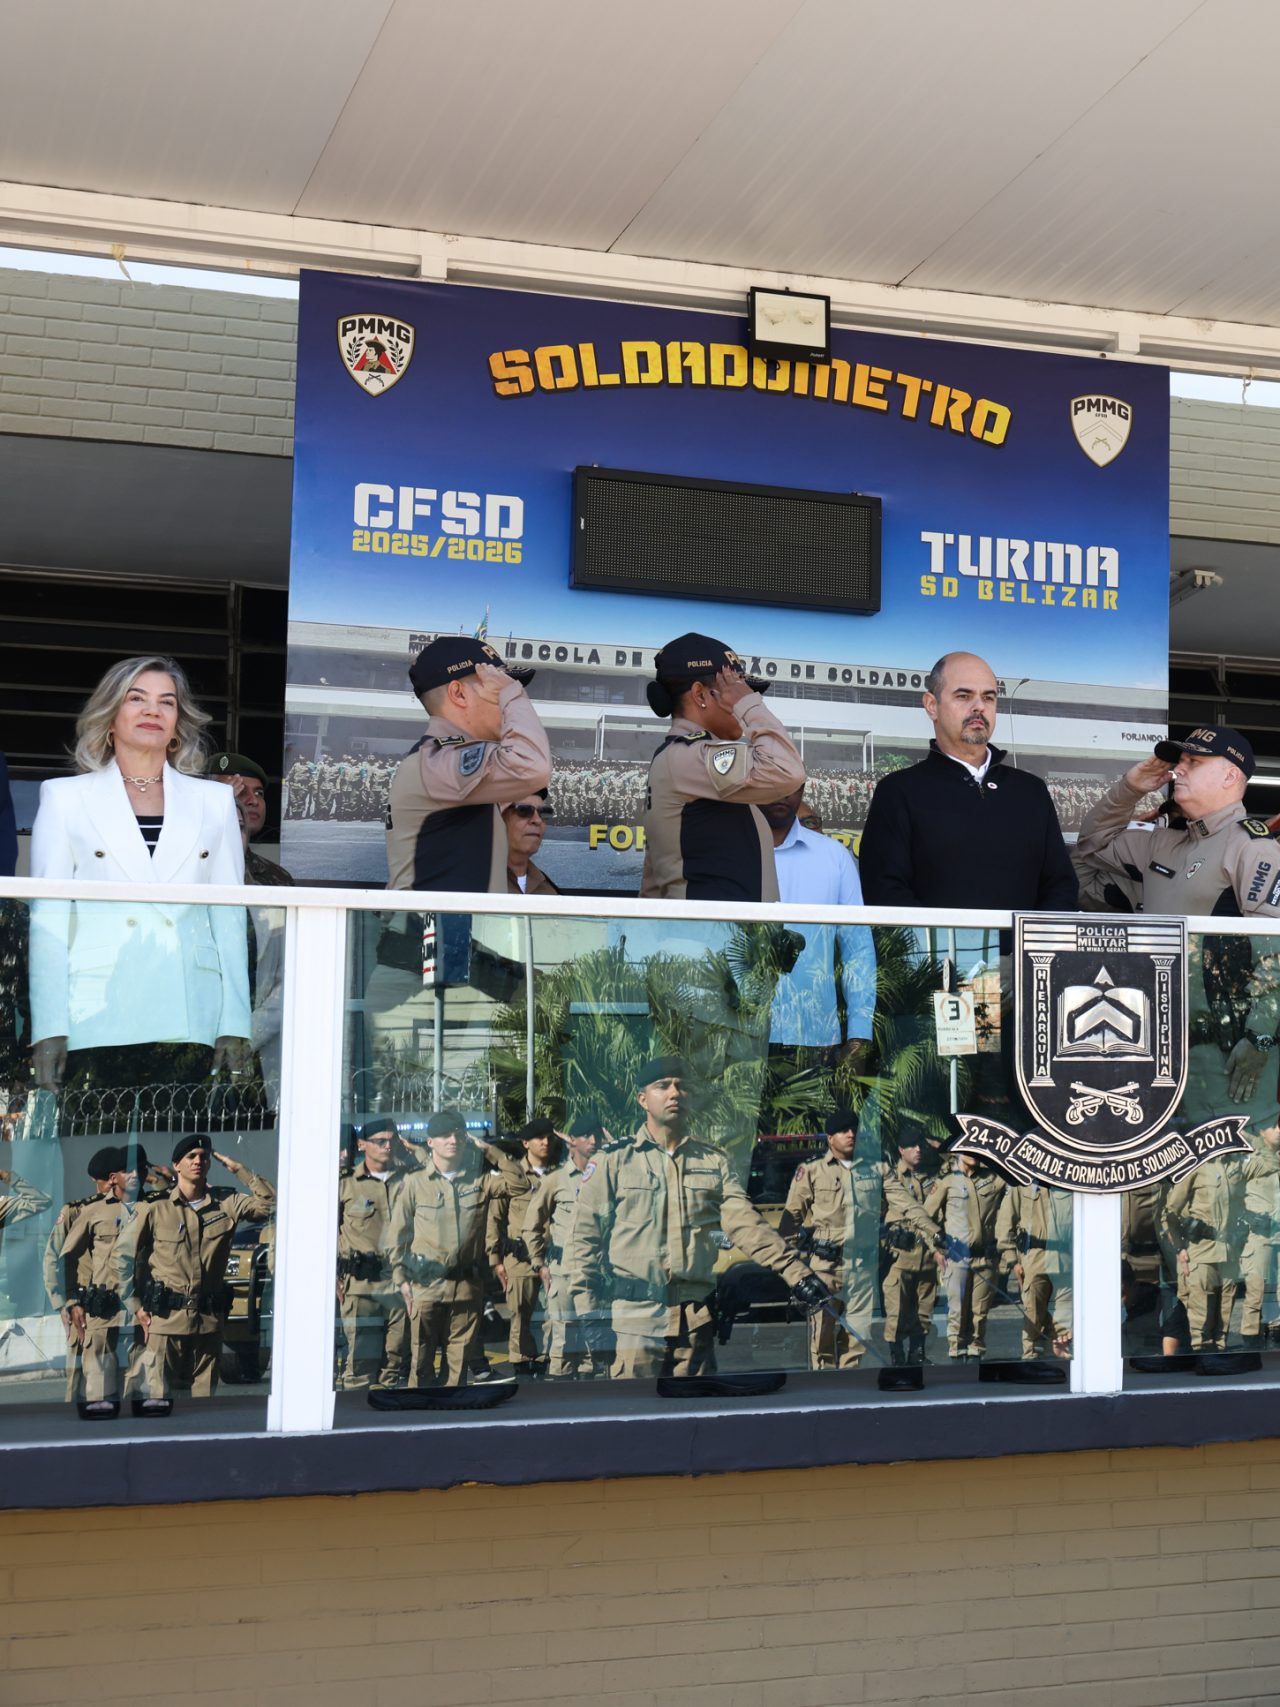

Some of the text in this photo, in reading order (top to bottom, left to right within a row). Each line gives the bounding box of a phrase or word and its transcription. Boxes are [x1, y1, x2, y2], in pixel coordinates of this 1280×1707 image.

[341, 317, 411, 345] PMMG
[1073, 397, 1130, 421] PMMG
[353, 482, 525, 540] CFSD
[352, 529, 524, 565] 2025/2026
[920, 530, 1120, 588] TURMA
[920, 574, 1119, 611] SD BELIZAR
[614, 649, 643, 668] DE
[790, 662, 816, 680] DE
[687, 659, 713, 669] POLICIA
[1121, 732, 1163, 742] FORJANDO
[1246, 860, 1272, 903] PMMG
[1077, 925, 1127, 937] POLÍCIA
[1077, 937, 1127, 948] MILITAR
[1037, 969, 1047, 1076] HIERARQUIA
[1160, 972, 1170, 1076] DISCIPLINA
[969, 1125, 1011, 1155] 24-10
[1195, 1127, 1235, 1154] 2001
[1016, 1140, 1187, 1187] ESCOLA DE FORMAÇÃO DE SOLDADOS
